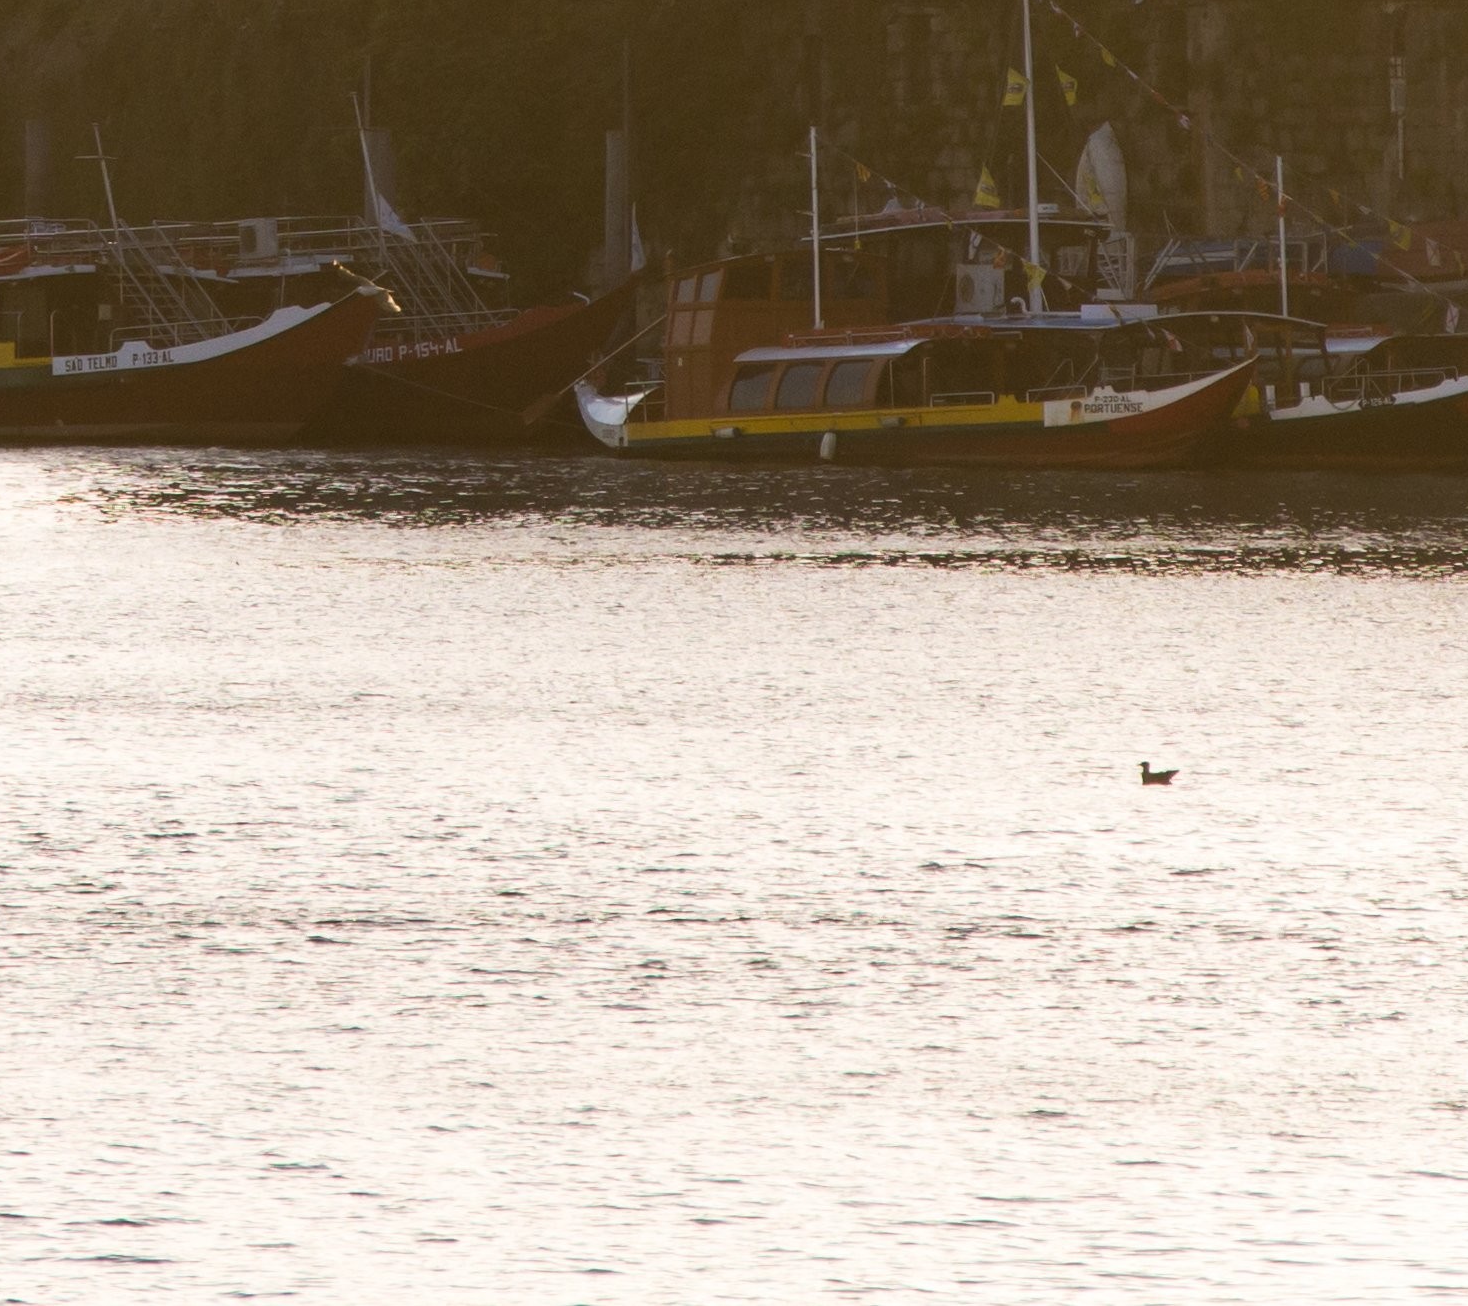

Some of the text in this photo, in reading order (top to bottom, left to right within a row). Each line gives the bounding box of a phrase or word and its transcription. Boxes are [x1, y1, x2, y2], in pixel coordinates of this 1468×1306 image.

[398, 337, 464, 361] P-154-AL
[87, 355, 118, 370] TELMO
[1084, 402, 1144, 414] PORTUENSE
